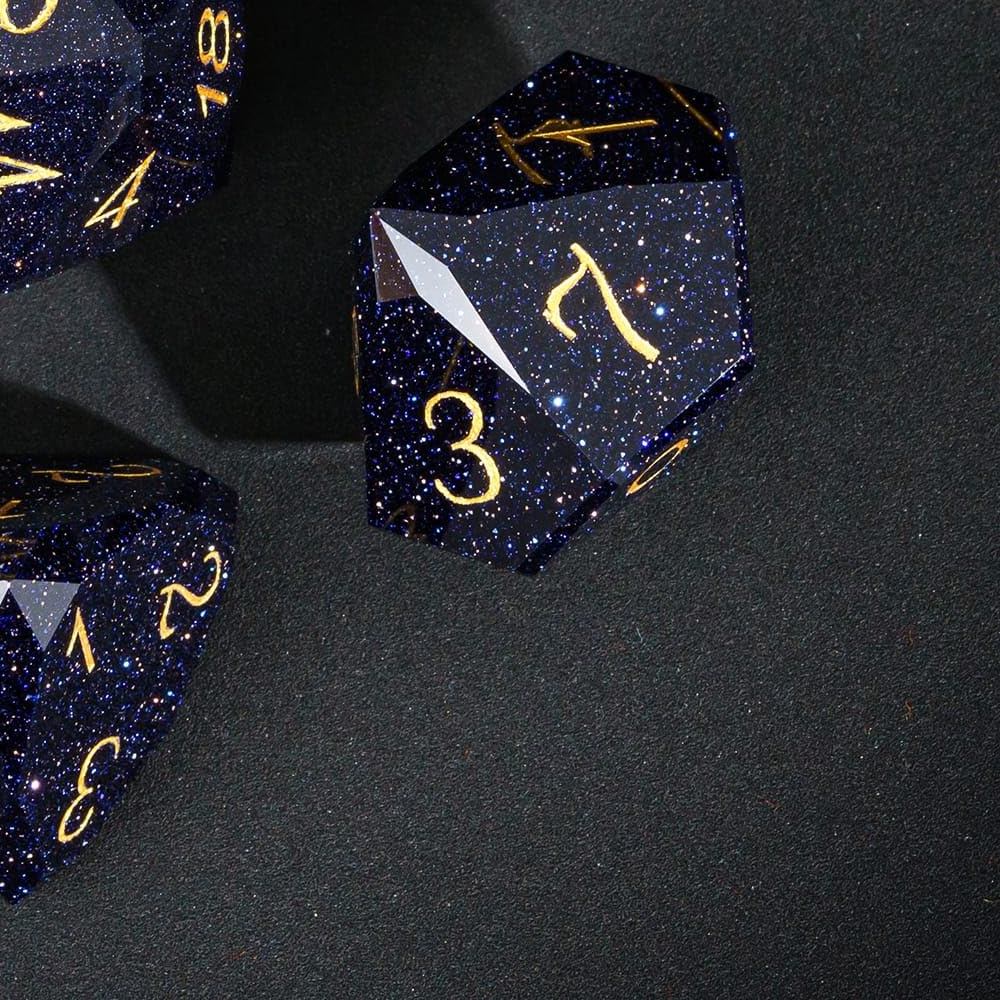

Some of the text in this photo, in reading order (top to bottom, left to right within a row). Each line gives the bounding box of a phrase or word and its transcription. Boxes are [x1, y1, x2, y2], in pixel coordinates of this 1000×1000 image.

[194, 7, 231, 118] 18
[84, 151, 156, 229] 4
[543, 243, 660, 364] 7
[423, 389, 502, 506] 3
[65, 606, 97, 674] 1
[158, 549, 222, 641] 2
[57, 735, 122, 844] 3
